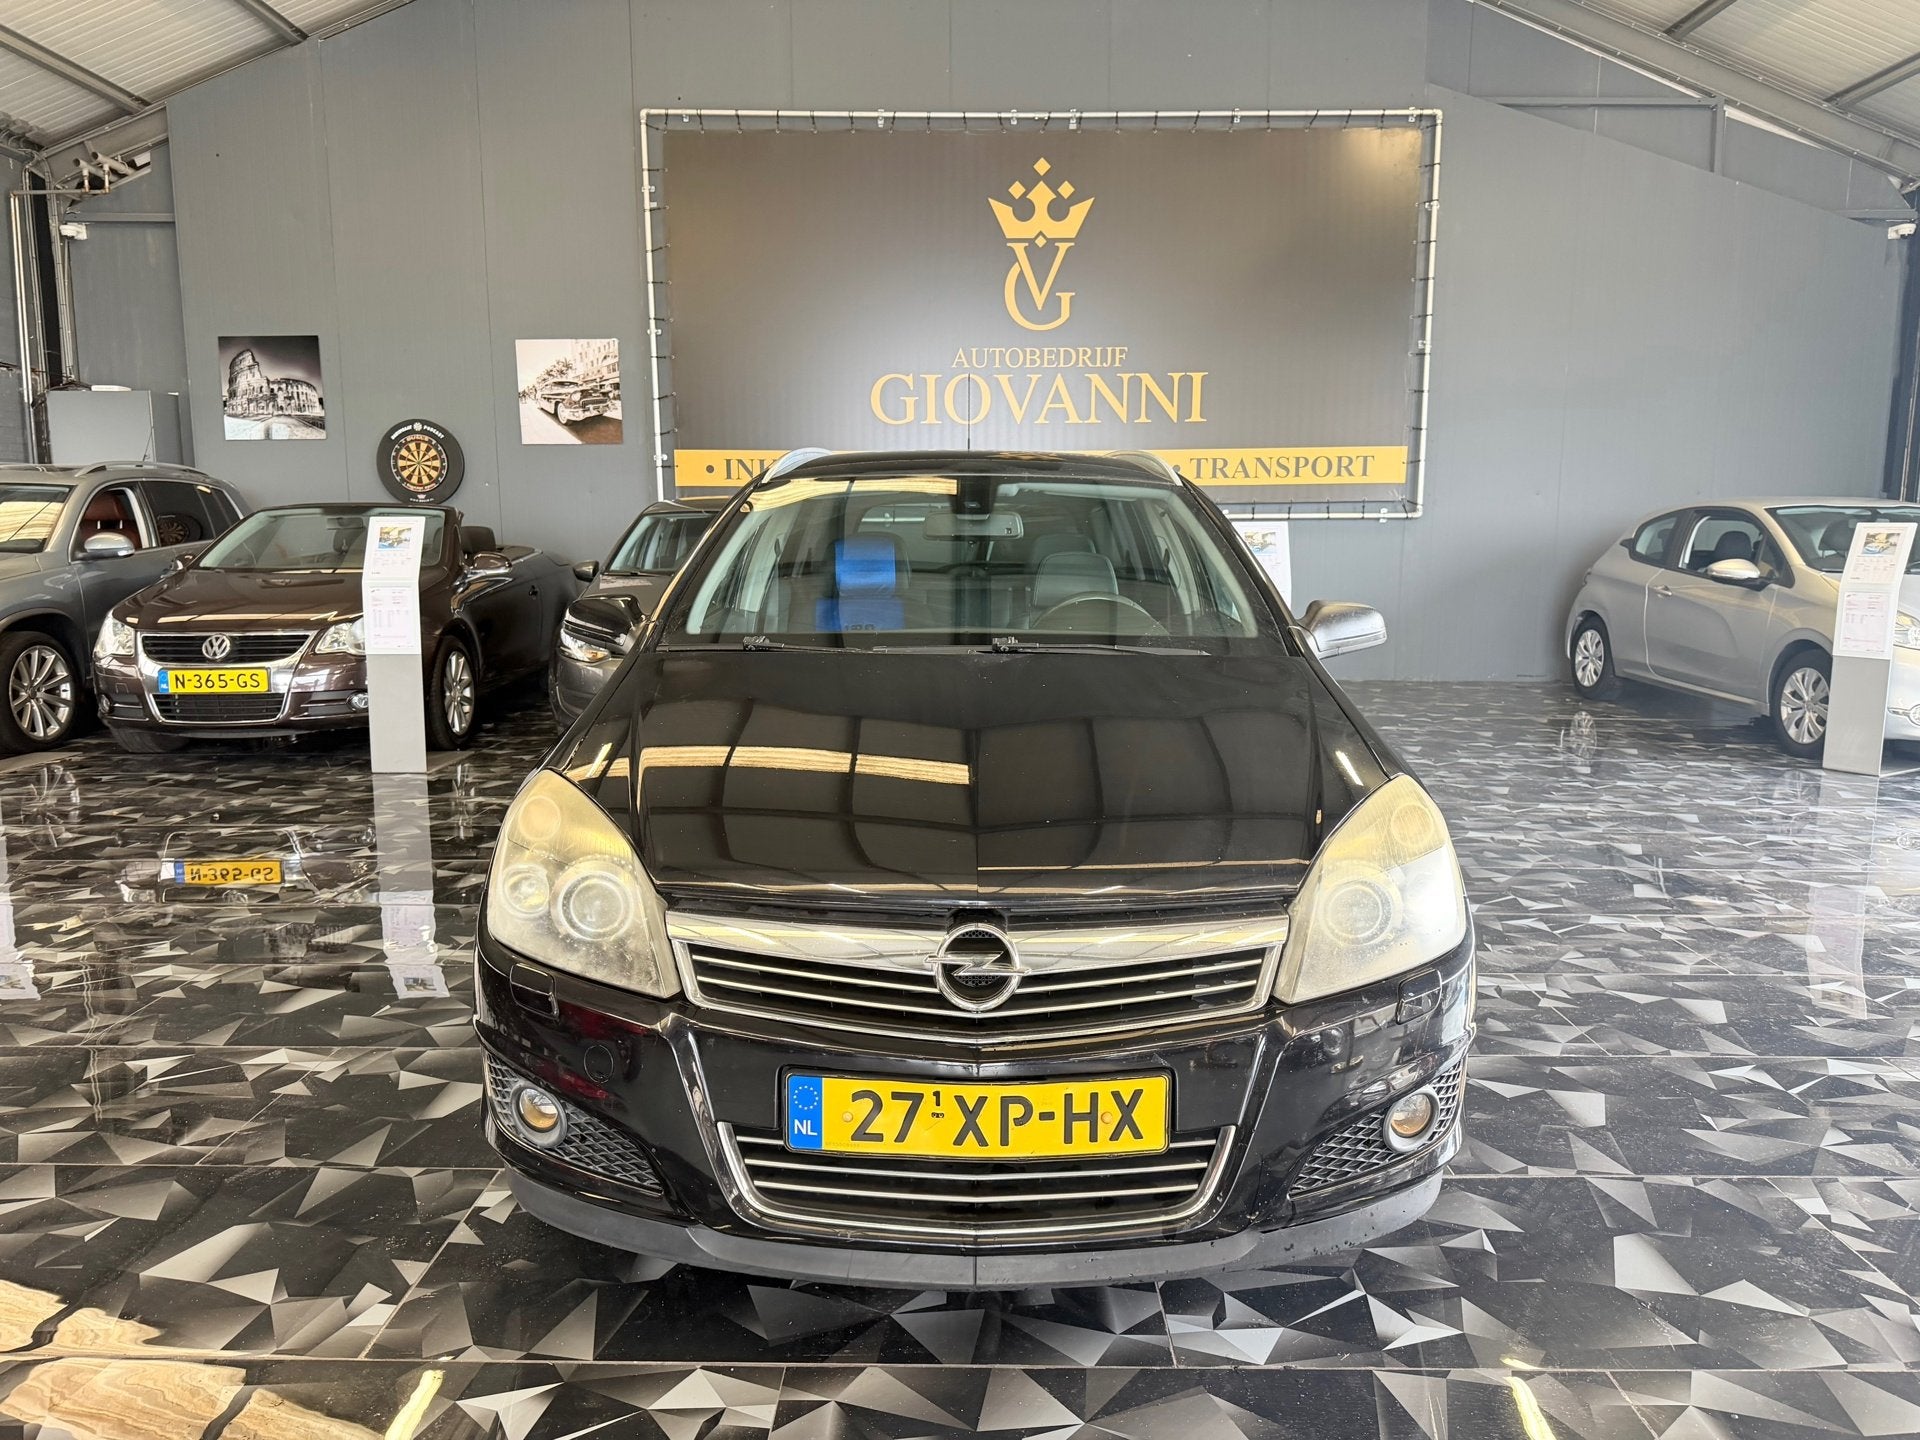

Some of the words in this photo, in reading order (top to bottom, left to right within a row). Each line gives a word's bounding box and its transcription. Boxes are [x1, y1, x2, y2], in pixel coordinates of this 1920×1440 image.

[951, 347, 1128, 368] AUTOBEDRIJF
[869, 372, 1209, 425] GIOVANNI
[1190, 455, 1375, 479] TRANSPORT
[174, 673, 260, 689] N-365-GS
[794, 1119, 818, 1136] NL
